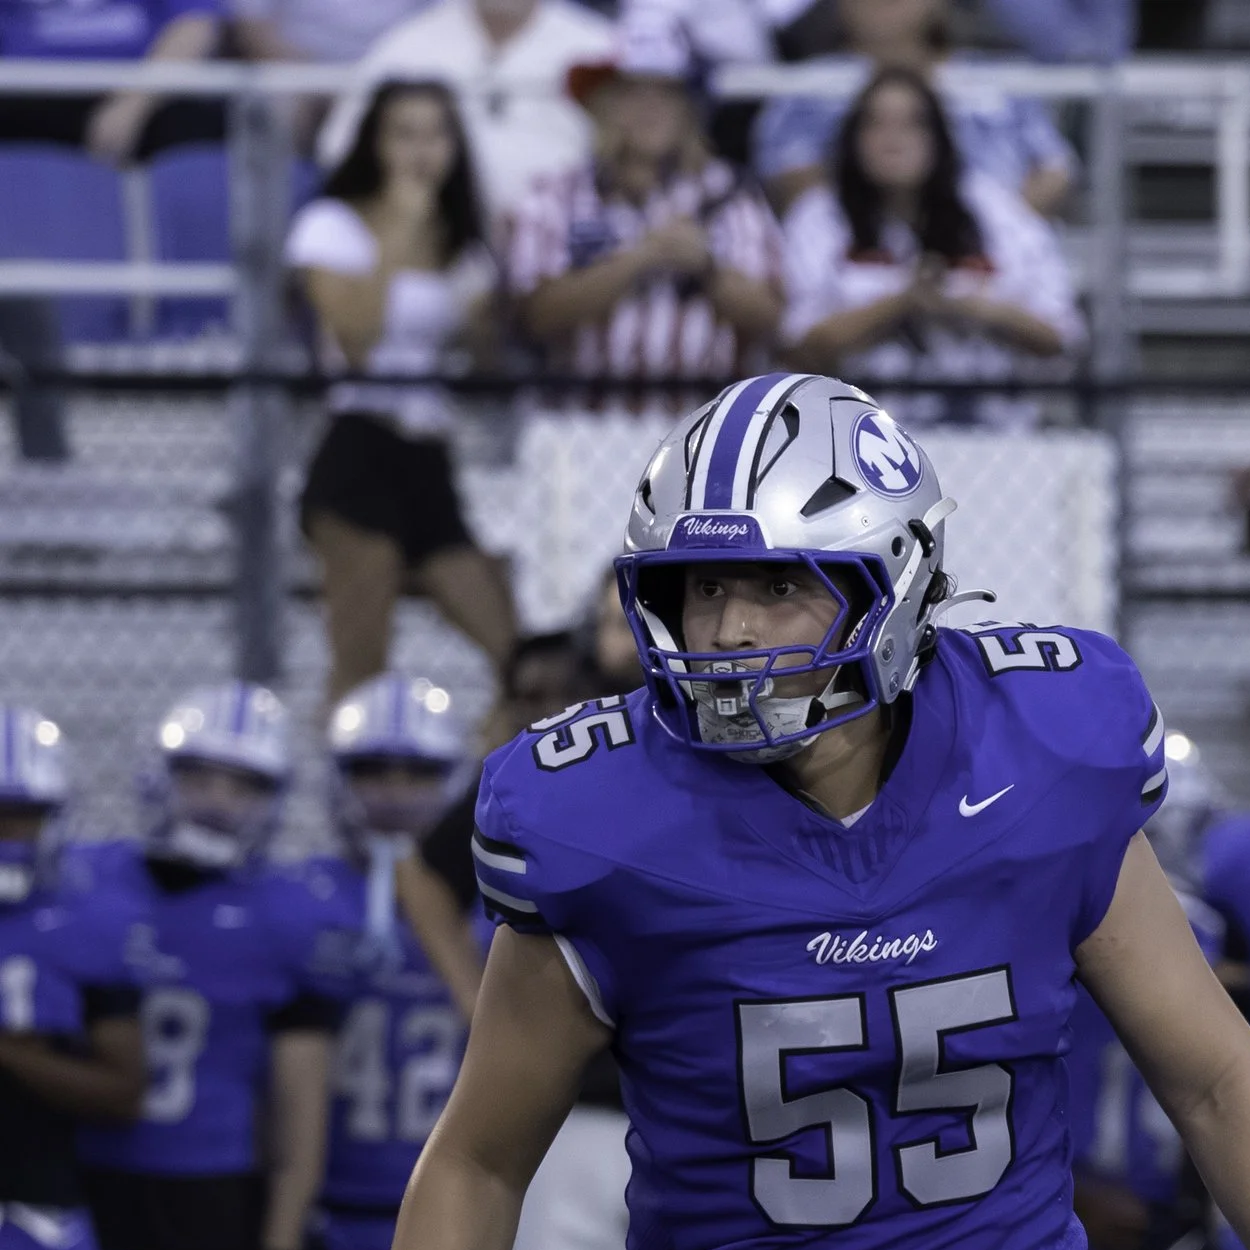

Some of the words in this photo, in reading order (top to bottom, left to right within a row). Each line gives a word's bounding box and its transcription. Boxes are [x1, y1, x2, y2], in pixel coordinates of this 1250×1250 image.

[683, 517, 749, 540] Vikings
[957, 620, 1083, 678] 5
[527, 695, 636, 773] 5
[806, 929, 938, 965] Vikings
[334, 1000, 465, 1142] 42
[733, 963, 1019, 1233] 55
